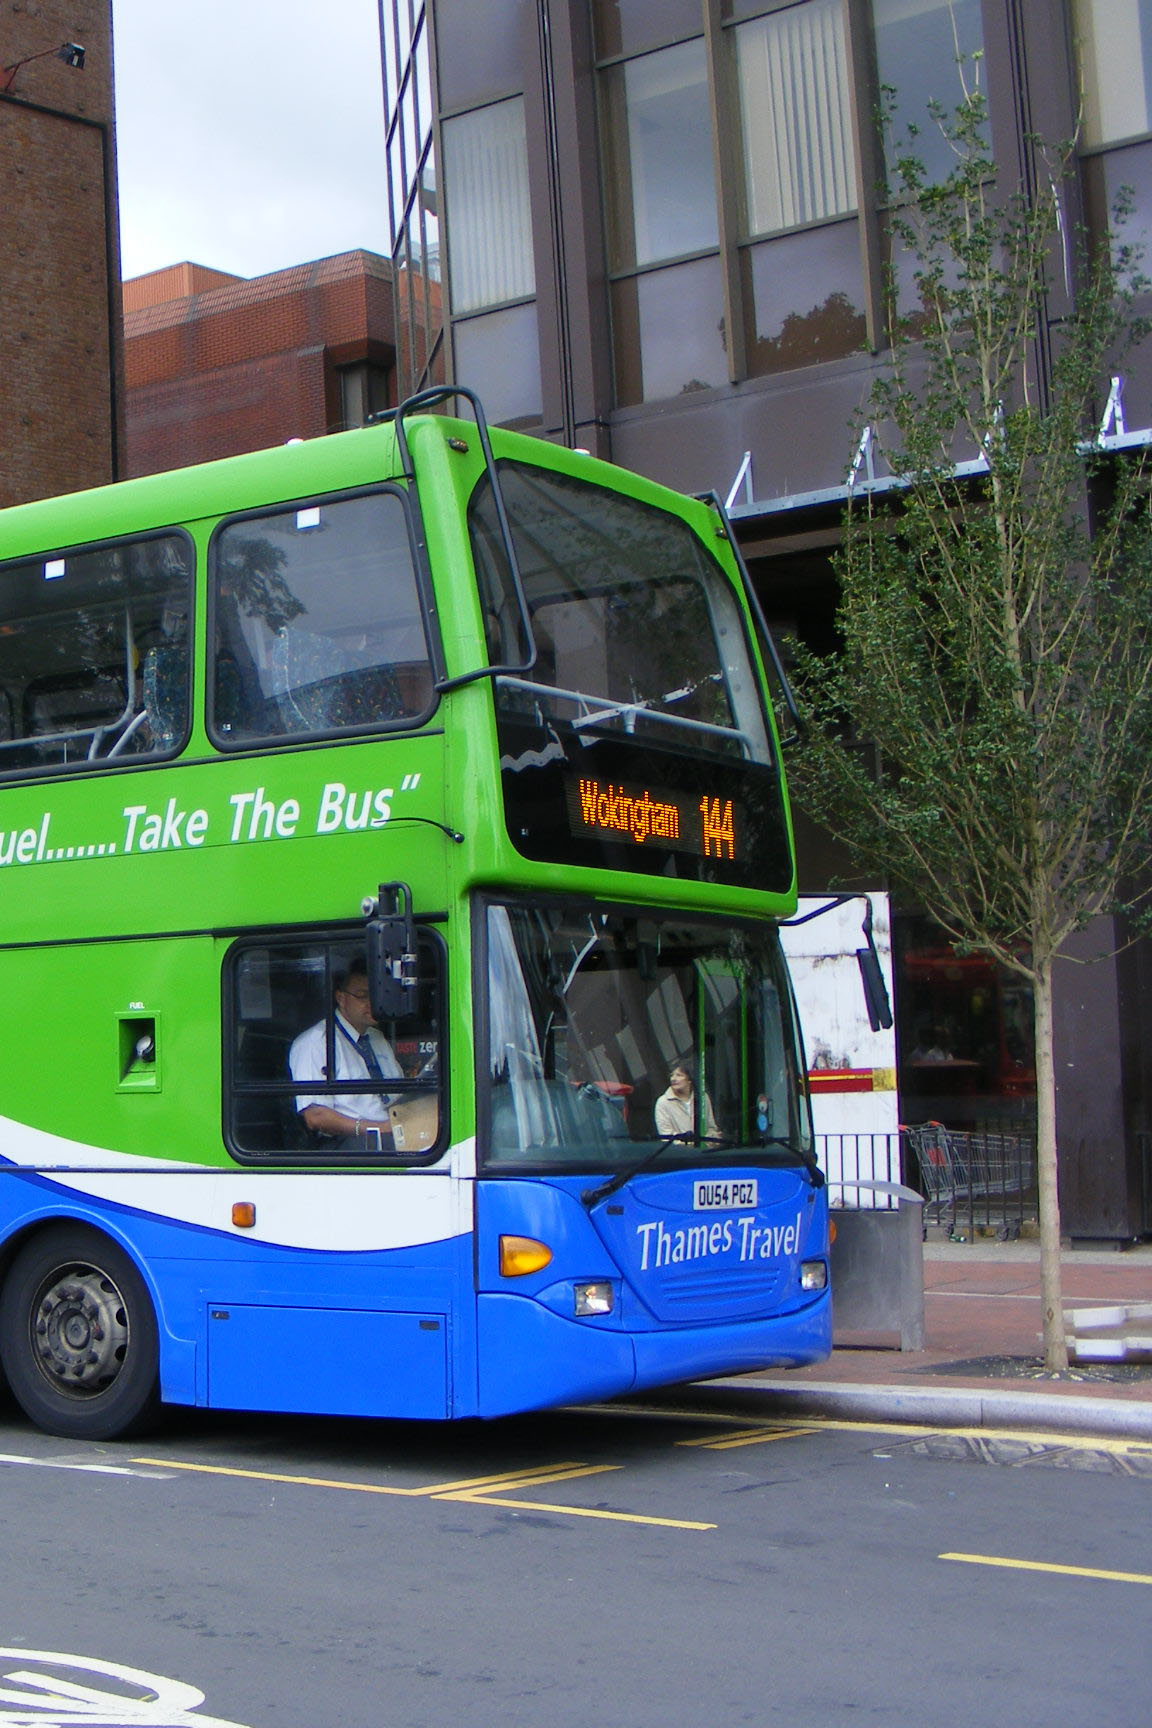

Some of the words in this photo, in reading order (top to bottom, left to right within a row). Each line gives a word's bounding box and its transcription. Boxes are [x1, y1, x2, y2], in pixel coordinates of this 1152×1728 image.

[123, 797, 209, 852] Take
[229, 787, 301, 841] The
[316, 773, 421, 833] Bus"
[579, 779, 680, 843] Wokingham
[699, 795, 735, 860] 144
[419, 1041, 438, 1053] zer
[698, 1184, 729, 1207] OU54
[731, 1183, 754, 1205] PGZ
[636, 1219, 733, 1271] Thames
[738, 1212, 802, 1262] Travel
